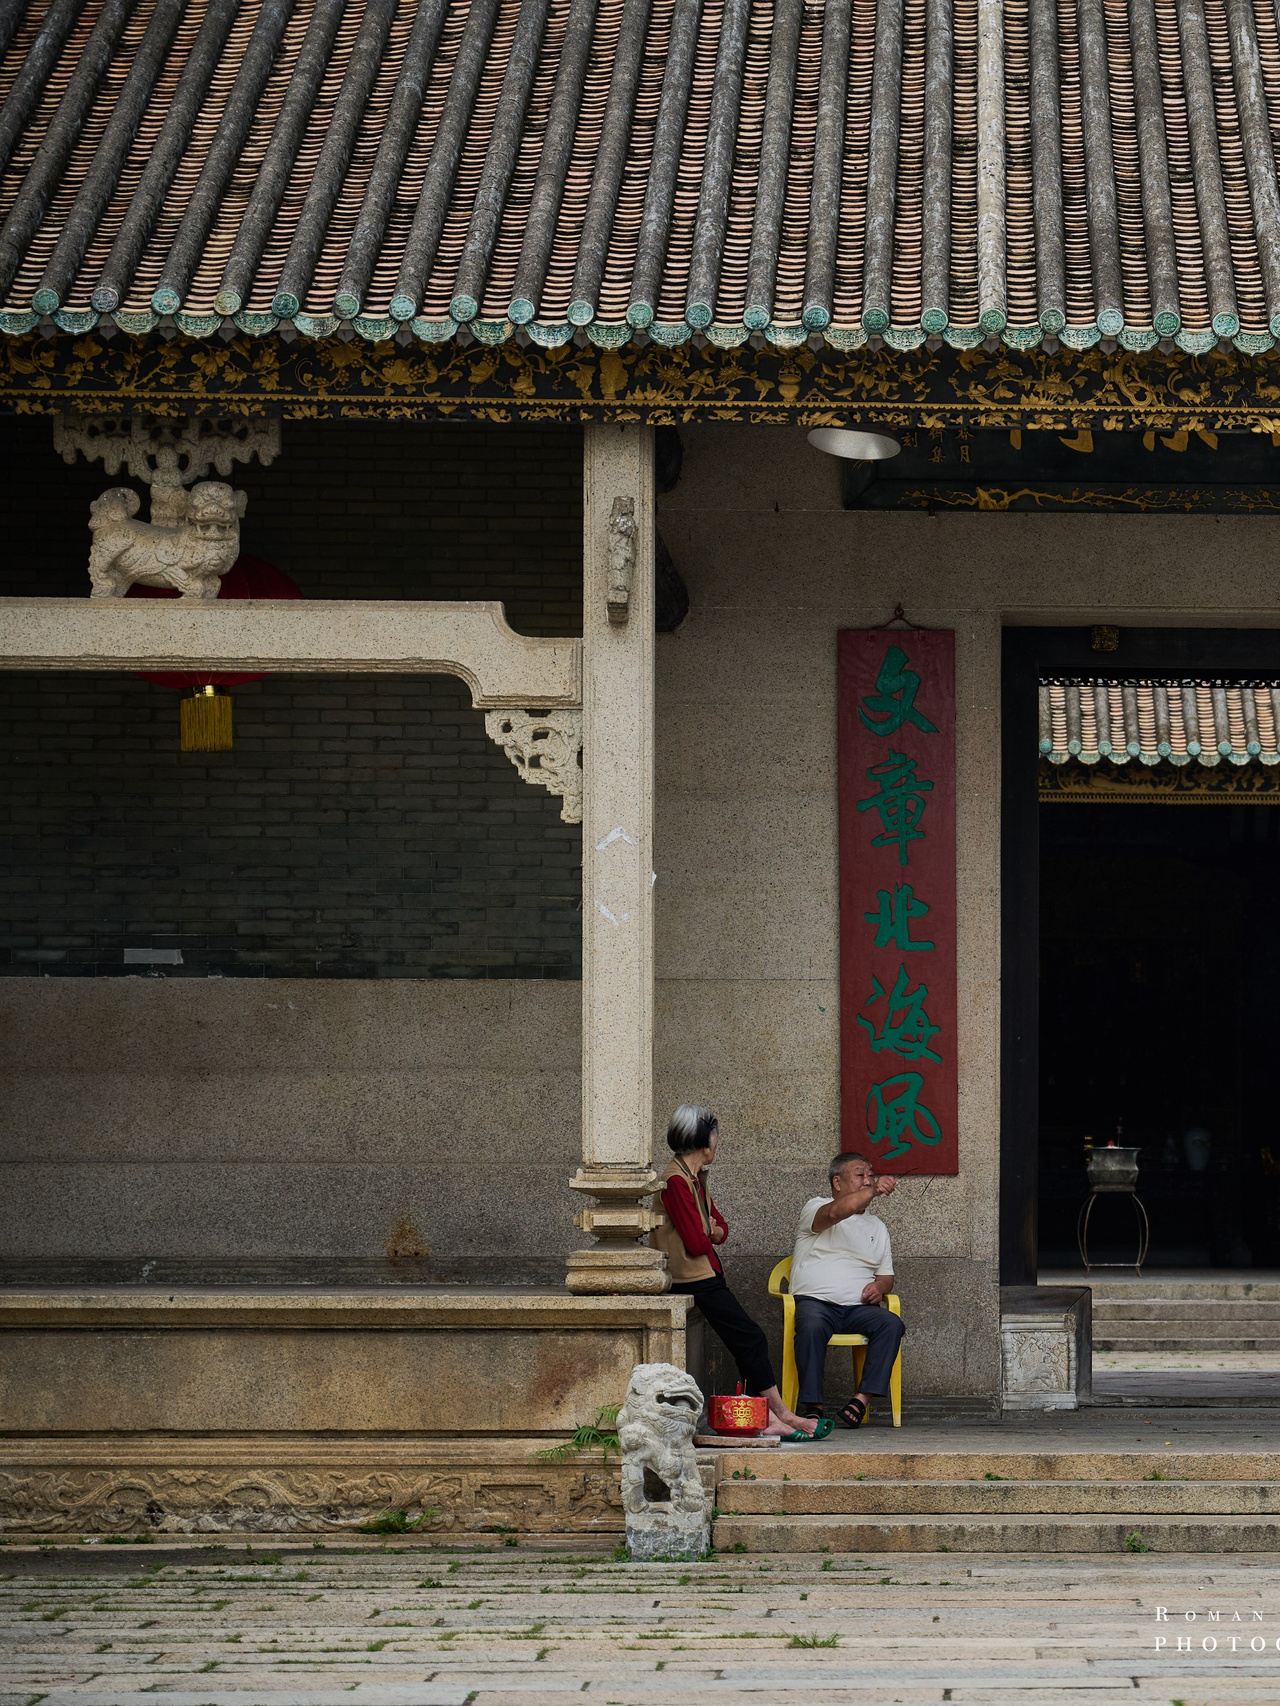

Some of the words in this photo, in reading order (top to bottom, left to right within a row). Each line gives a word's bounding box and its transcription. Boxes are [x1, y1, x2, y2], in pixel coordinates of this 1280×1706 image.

[856, 645, 942, 1160] 文章北海風
